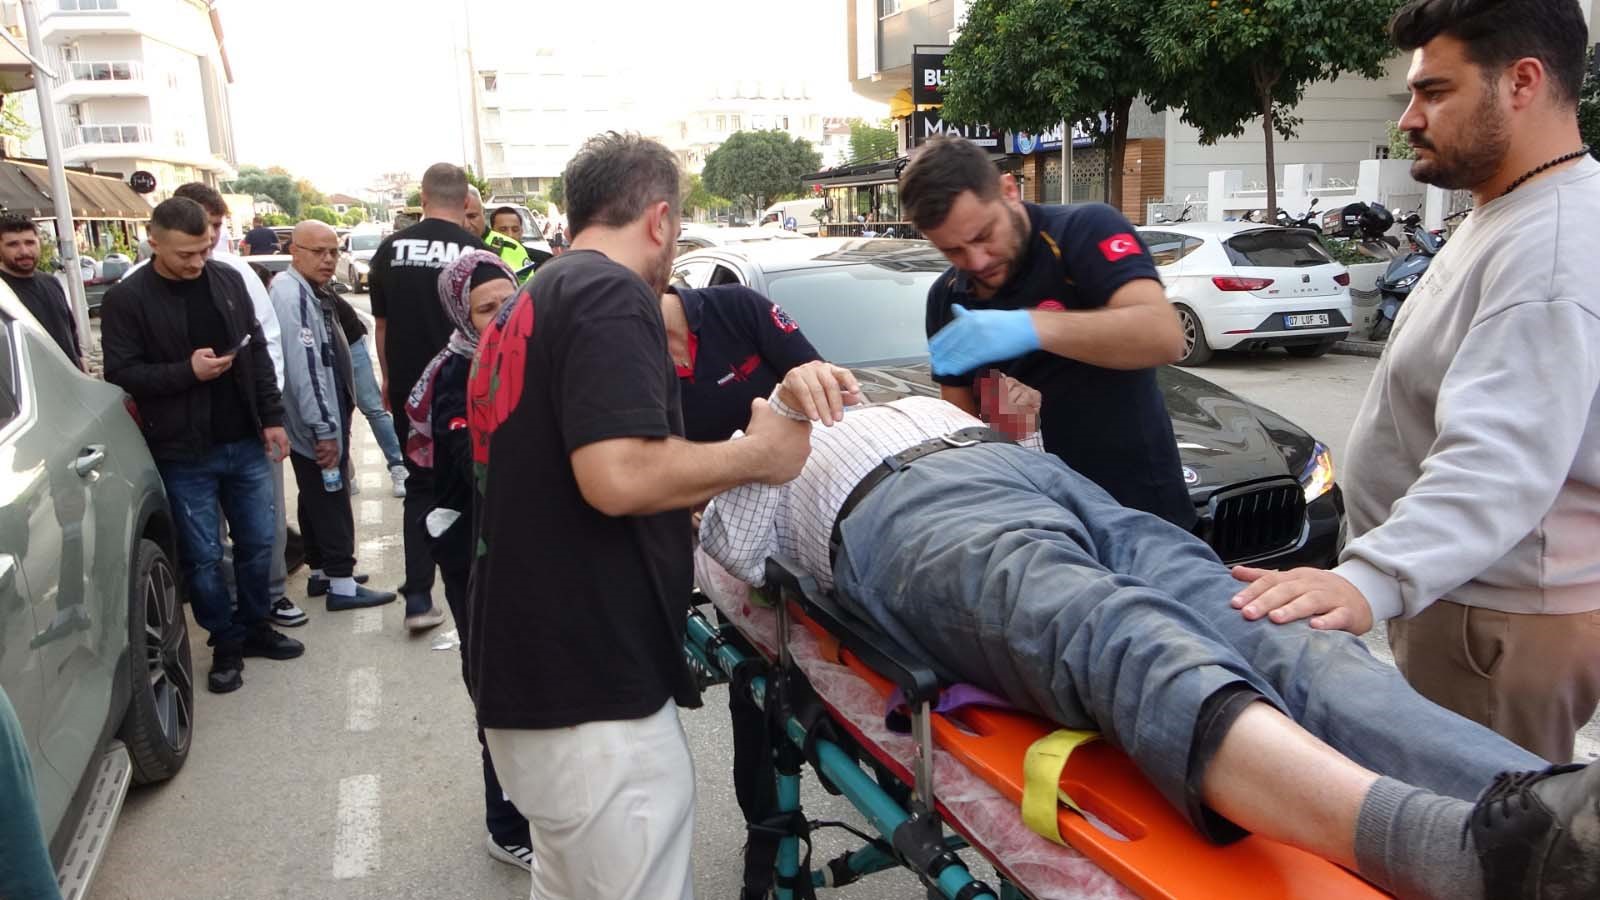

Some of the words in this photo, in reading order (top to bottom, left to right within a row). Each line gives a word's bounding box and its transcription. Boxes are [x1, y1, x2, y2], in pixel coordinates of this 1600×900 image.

[924, 69, 951, 86] BU
[392, 239, 475, 263] TEAM
[1289, 316, 1298, 326] 07
